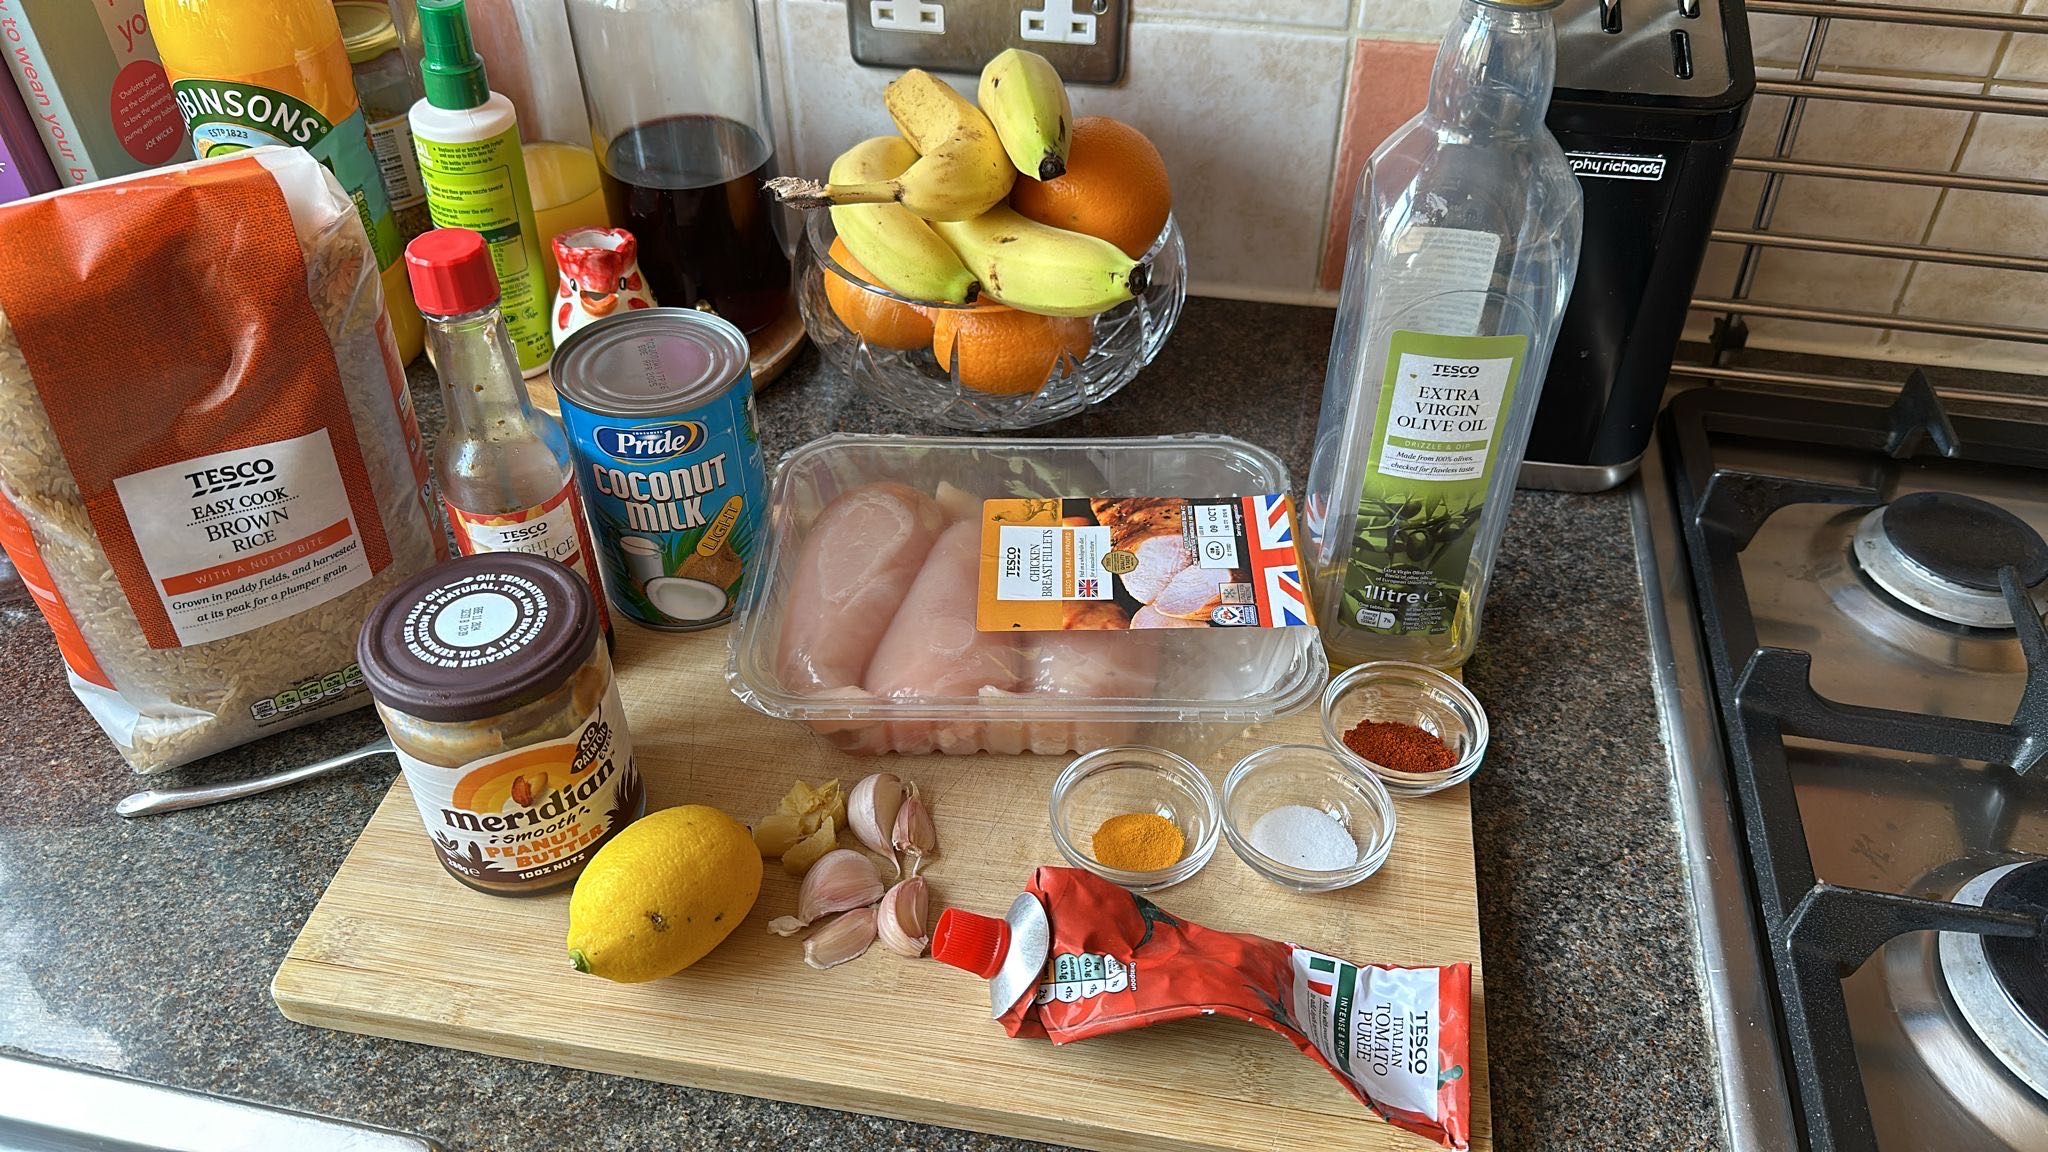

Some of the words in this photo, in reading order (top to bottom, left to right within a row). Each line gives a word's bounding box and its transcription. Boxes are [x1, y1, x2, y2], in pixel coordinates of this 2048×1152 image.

[144, 73, 157, 86] gave
[3, 17, 20, 42] to
[15, 47, 51, 106] wean
[39, 112, 77, 161] your
[69, 167, 87, 184] b
[120, 106, 129, 116] me
[129, 100, 138, 109] the
[138, 83, 165, 103] confidence
[129, 113, 142, 123] love
[141, 107, 150, 115] the
[150, 93, 172, 109] weaning
[176, 88, 319, 142] OBINSONS
[123, 127, 143, 144] journey
[143, 119, 154, 129] with
[145, 139, 156, 150] JOE
[155, 126, 174, 142] WICKS
[227, 129, 248, 139] 1823
[1569, 160, 1600, 173] rphy
[1603, 161, 1660, 175] richards
[1433, 364, 1479, 375] TESCO
[1419, 386, 1480, 401] EXTRA
[1416, 402, 1479, 417] VIRGIN
[1397, 415, 1453, 432] OLIVE
[1458, 419, 1487, 432] OIL
[616, 430, 685, 454] Pride
[1405, 441, 1441, 450] DRIZZLE
[1391, 462, 1418, 472] checked
[1418, 464, 1429, 474] for
[1429, 465, 1458, 474] flawless
[1458, 465, 1474, 473] taste
[1397, 451, 1416, 460] Made
[1416, 452, 1434, 462] from
[185, 458, 274, 489] TESCO
[592, 453, 728, 501] COCONUT
[191, 498, 234, 520] EASY
[239, 487, 289, 508] COOK
[626, 496, 706, 532] MILK
[1208, 507, 1217, 522] OCT
[1233, 504, 1242, 523] Suggestion
[204, 507, 289, 542] BROWN
[500, 522, 547, 540] TESCO
[702, 502, 739, 550] LIGHT
[1209, 525, 1218, 533] 09
[232, 530, 277, 552] RICE
[545, 536, 575, 560] UCE
[1042, 529, 1053, 561] FILLETS
[195, 568, 231, 584] WITH
[237, 565, 246, 574] A
[250, 550, 292, 569] NUTTY
[298, 535, 326, 553] BITE
[1006, 546, 1016, 577] TESCO
[1029, 544, 1041, 582] CHICKEN
[172, 596, 209, 611] Grown
[211, 592, 223, 602] in
[225, 581, 258, 602] paddy
[257, 570, 291, 591] fields,
[291, 562, 312, 576] and
[313, 540, 358, 567] harvested
[476, 574, 496, 582] OIL
[1042, 564, 1053, 597] BREAST
[197, 613, 208, 622] at
[210, 606, 224, 619] its
[226, 600, 252, 618] peak
[250, 597, 269, 610] for
[271, 593, 279, 601] a
[279, 579, 322, 602] plumper
[322, 563, 348, 582] grain
[425, 588, 445, 601] OIL
[436, 582, 499, 604] NATURAL,
[499, 574, 548, 609] SEPARATION
[500, 584, 525, 600] STIR
[1364, 585, 1420, 603] 1litre
[405, 601, 427, 624] PALM
[425, 603, 439, 613] IS
[521, 597, 534, 616] AND
[403, 626, 415, 642] USE
[418, 614, 456, 657] SEPARATION
[499, 617, 533, 648] ENJOY!
[520, 610, 548, 645] OCCURS
[407, 641, 438, 665] NEVER
[438, 659, 458, 668] WE
[459, 650, 480, 658] OIL
[461, 644, 520, 668] BECAUSE
[574, 743, 599, 770] PALM
[597, 722, 607, 744] OIL
[580, 726, 595, 750] NO
[441, 759, 615, 832] meridian
[503, 812, 576, 843] smooth
[484, 823, 582, 858] PEANUT
[515, 824, 604, 868] BUTTER
[519, 867, 551, 880] 100%
[554, 853, 585, 871] NUTS
[1059, 960, 1068, 980] <0.1g
[1084, 958, 1092, 978] <0.1g
[1322, 999, 1330, 1016] Made
[1338, 997, 1349, 1031] INTENSE
[1356, 1010, 1373, 1062] PURÉE
[1373, 1003, 1391, 1076] TOMATO
[1391, 1017, 1403, 1068] ITALIAN
[1415, 1011, 1428, 1074] TESCO
